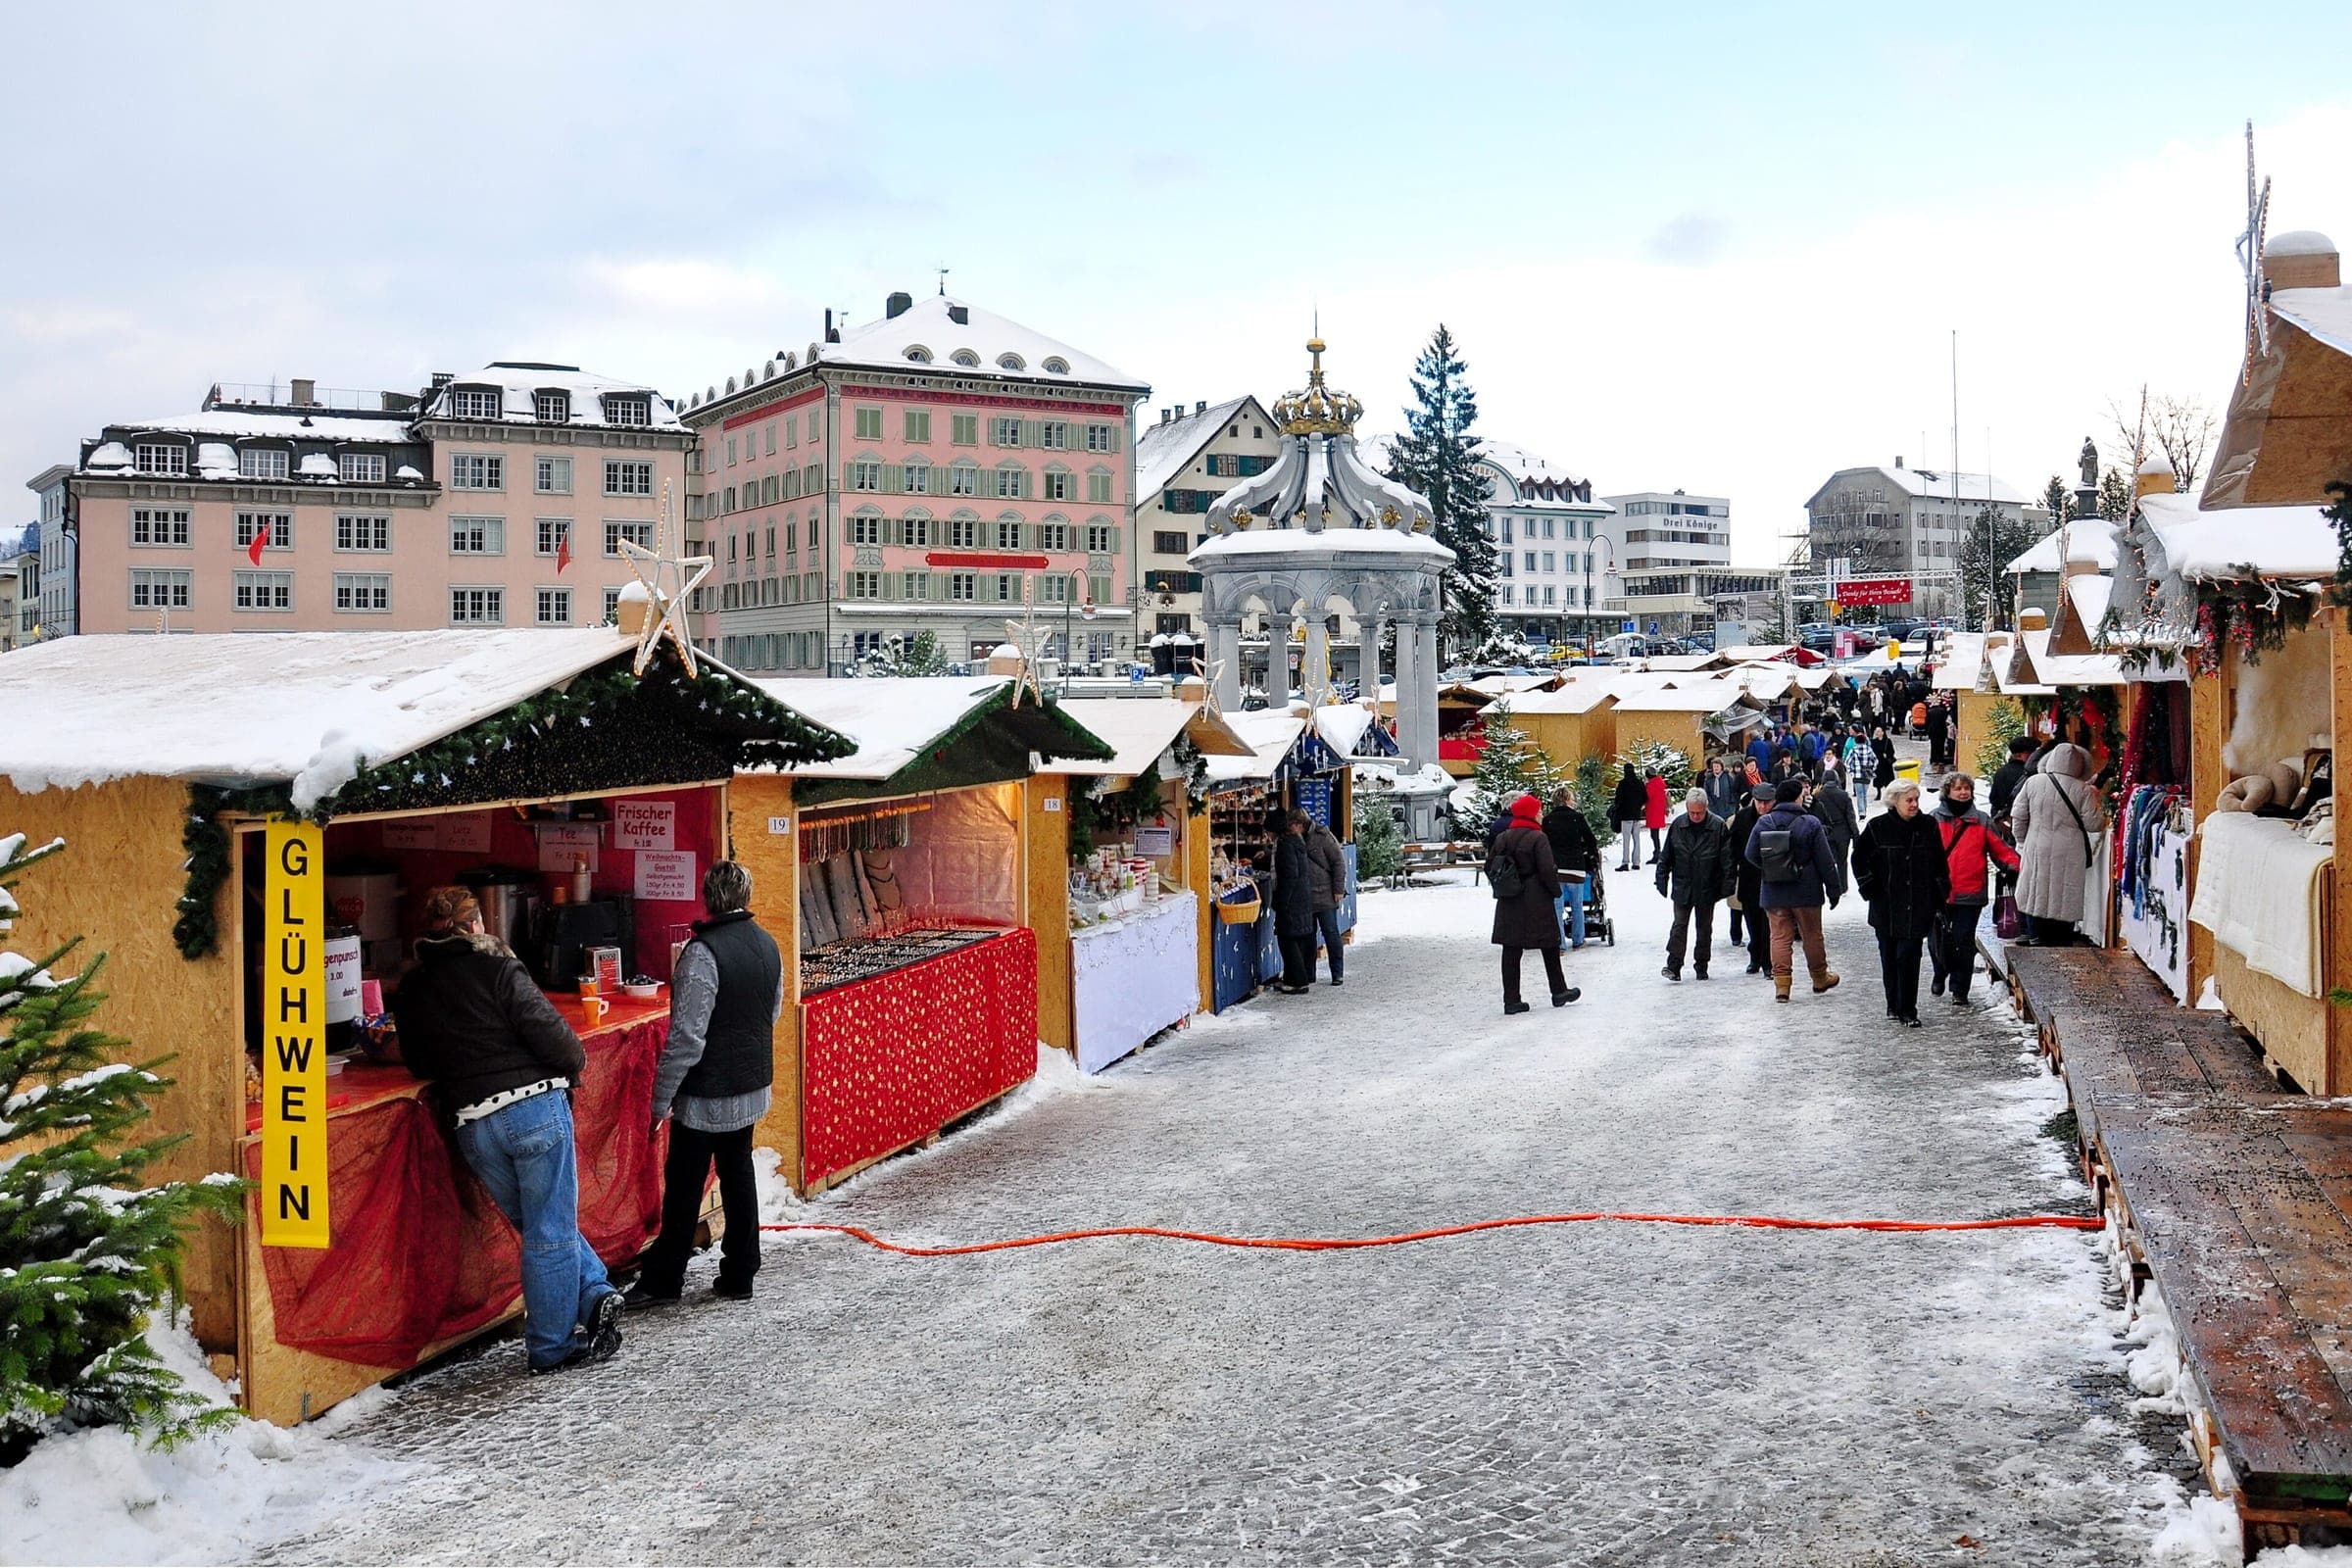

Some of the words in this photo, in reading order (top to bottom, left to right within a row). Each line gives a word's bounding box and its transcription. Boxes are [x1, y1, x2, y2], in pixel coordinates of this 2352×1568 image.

[1663, 517, 1683, 527] Drei
[1686, 519, 1718, 530] Könige
[1048, 799, 1058, 809] 18
[617, 805, 671, 820] Frischer
[623, 821, 666, 836] Kaffee
[773, 818, 786, 831] 19
[559, 826, 577, 839] Tee
[275, 838, 313, 1221] GLÜHWEIN
